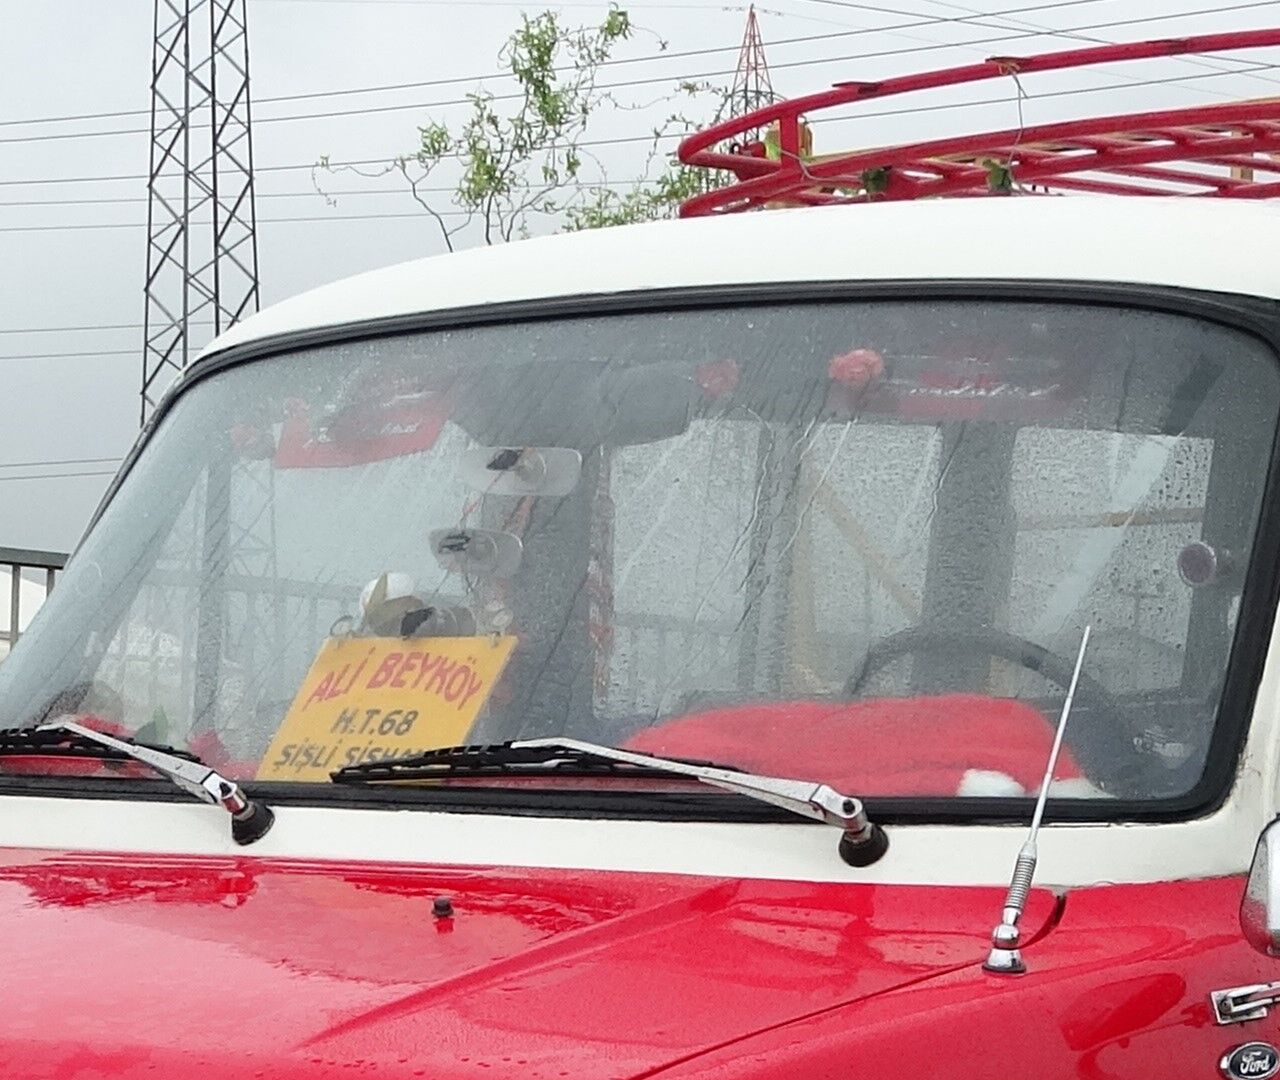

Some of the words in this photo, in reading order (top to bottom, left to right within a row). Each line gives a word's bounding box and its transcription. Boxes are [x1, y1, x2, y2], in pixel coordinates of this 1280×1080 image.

[302, 646, 376, 712] ALİ
[366, 651, 484, 711] BEYKÖY
[1240, 1051, 1271, 1074] Ford
